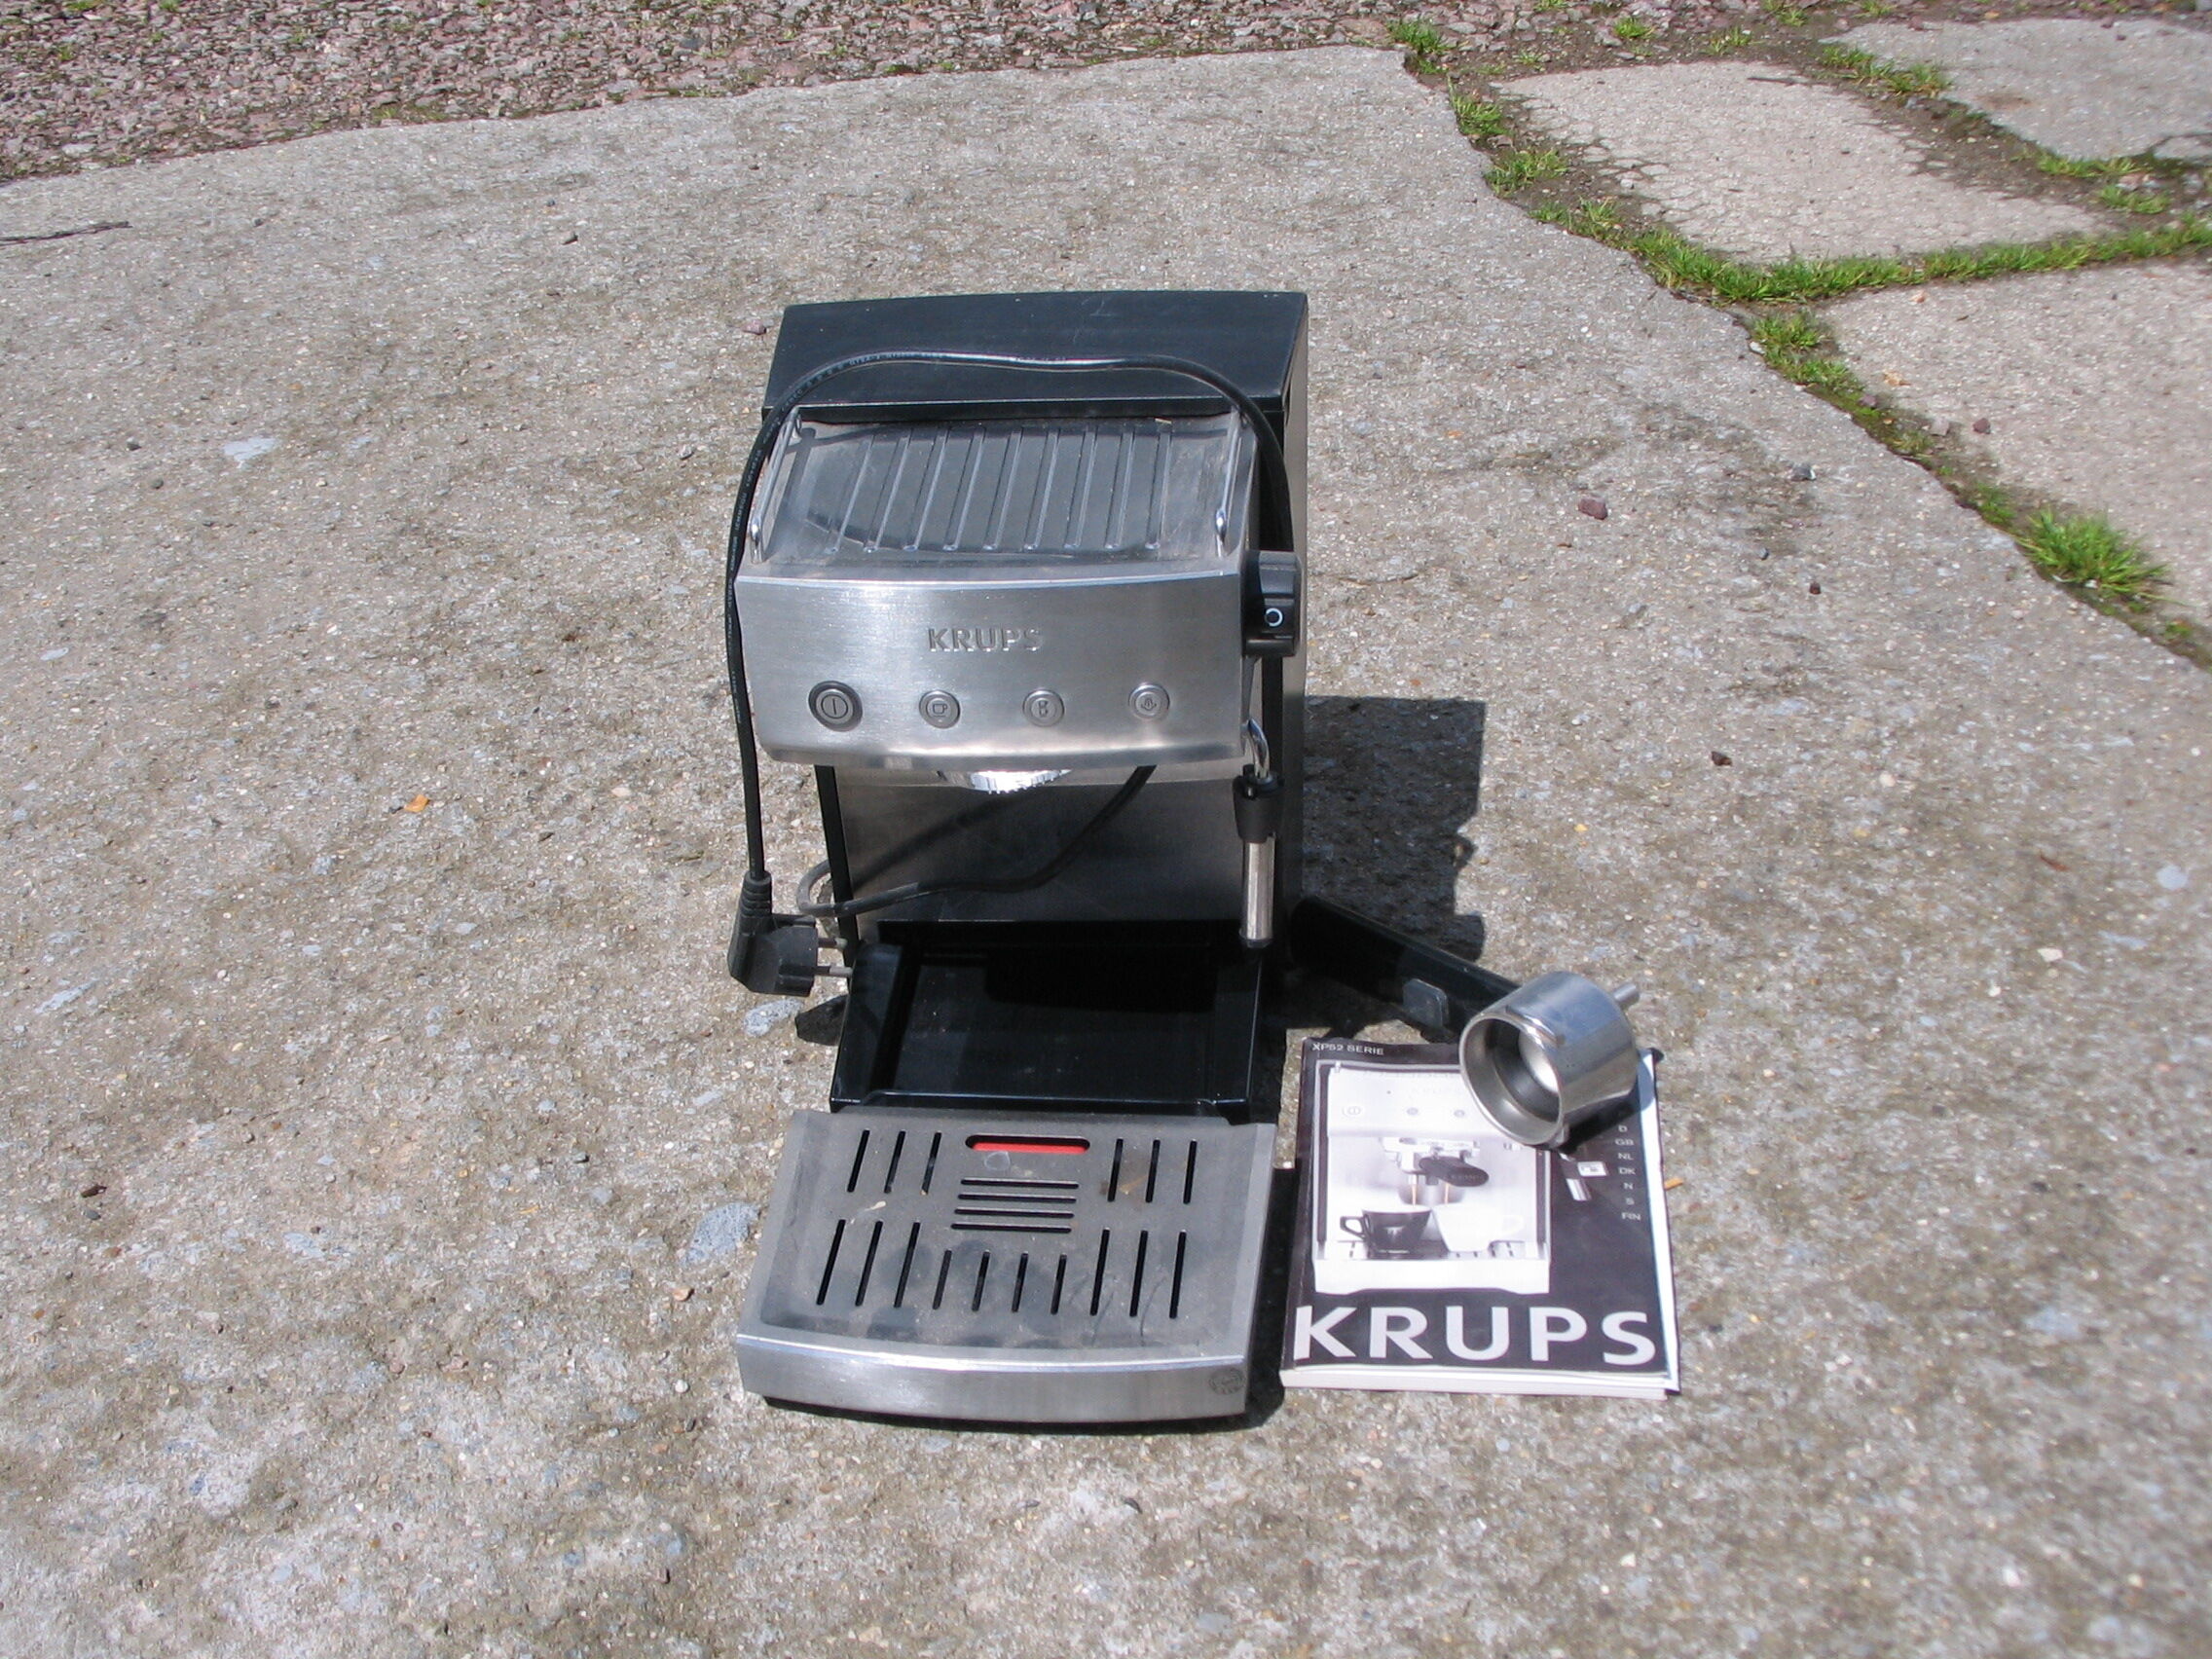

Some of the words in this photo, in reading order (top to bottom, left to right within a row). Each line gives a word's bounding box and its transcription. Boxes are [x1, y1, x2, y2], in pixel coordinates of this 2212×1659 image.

[928, 628, 1043, 651] KRUPS
[1346, 1044, 1383, 1055] SERIE
[1618, 1152, 1634, 1161] NL
[1293, 1306, 1657, 1366] KRUPS
